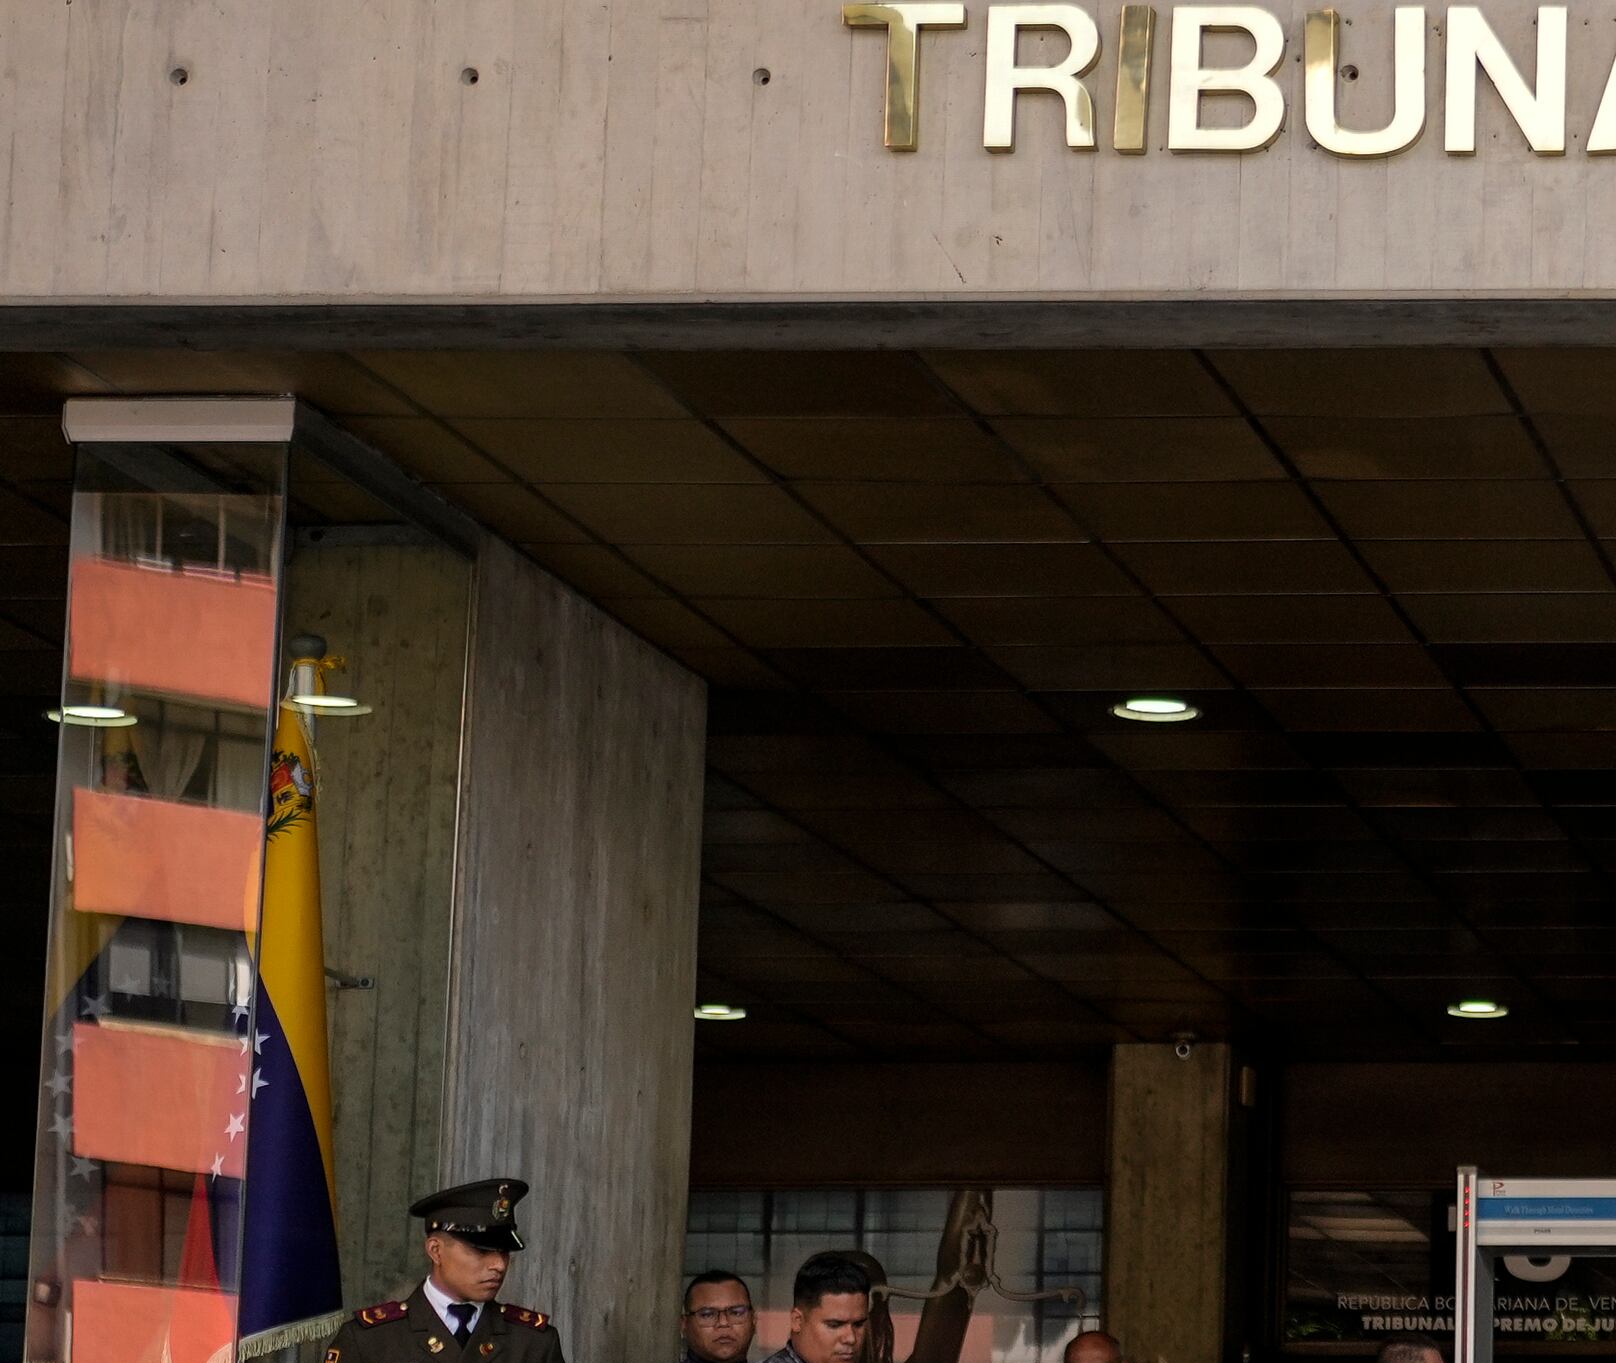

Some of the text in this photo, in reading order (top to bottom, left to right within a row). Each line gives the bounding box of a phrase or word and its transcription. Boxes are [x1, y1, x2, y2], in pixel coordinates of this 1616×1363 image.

[1555, 1296, 1580, 1311] DE
[1361, 1316, 1456, 1331] TRIBUNAL
[1562, 1317, 1587, 1332] DE
